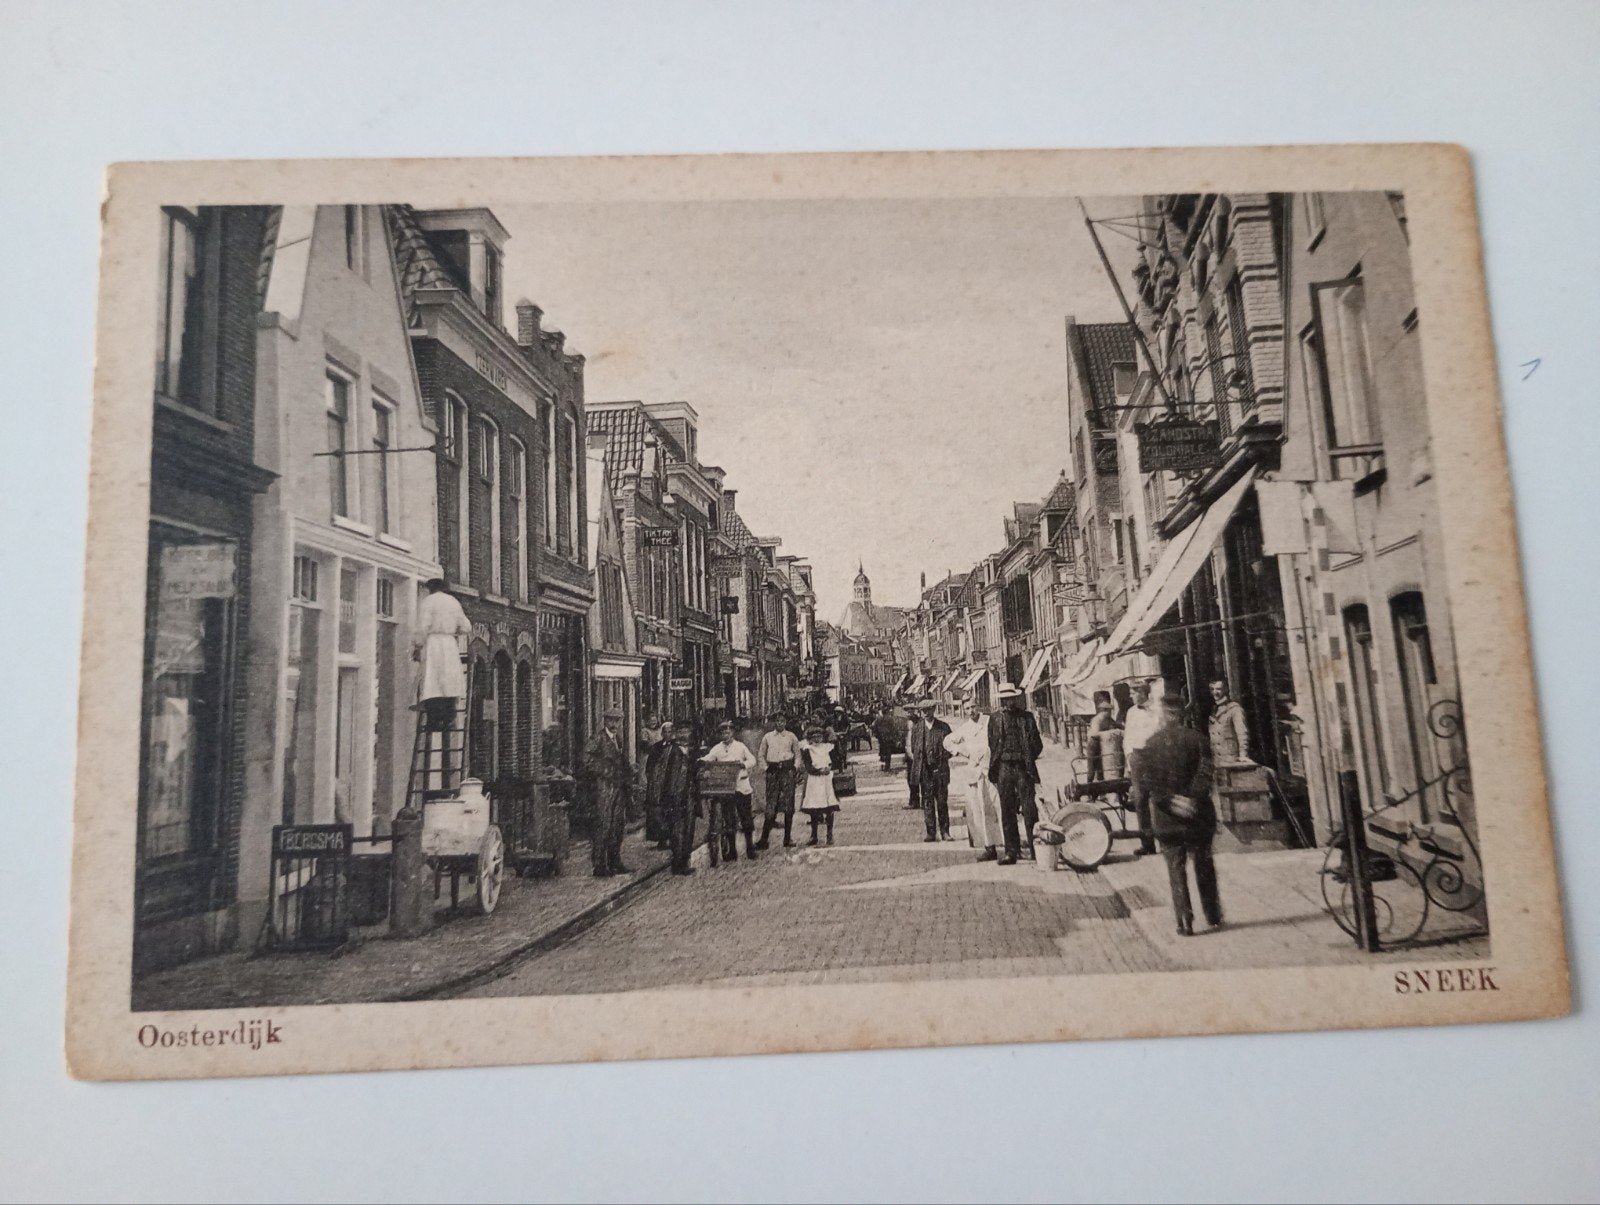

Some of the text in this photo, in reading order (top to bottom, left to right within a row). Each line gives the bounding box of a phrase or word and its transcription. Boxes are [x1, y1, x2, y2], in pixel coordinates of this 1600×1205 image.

[651, 537, 672, 545] THEE
[1395, 967, 1500, 994] SNEEK
[138, 1019, 283, 1050] Oosterdijk
